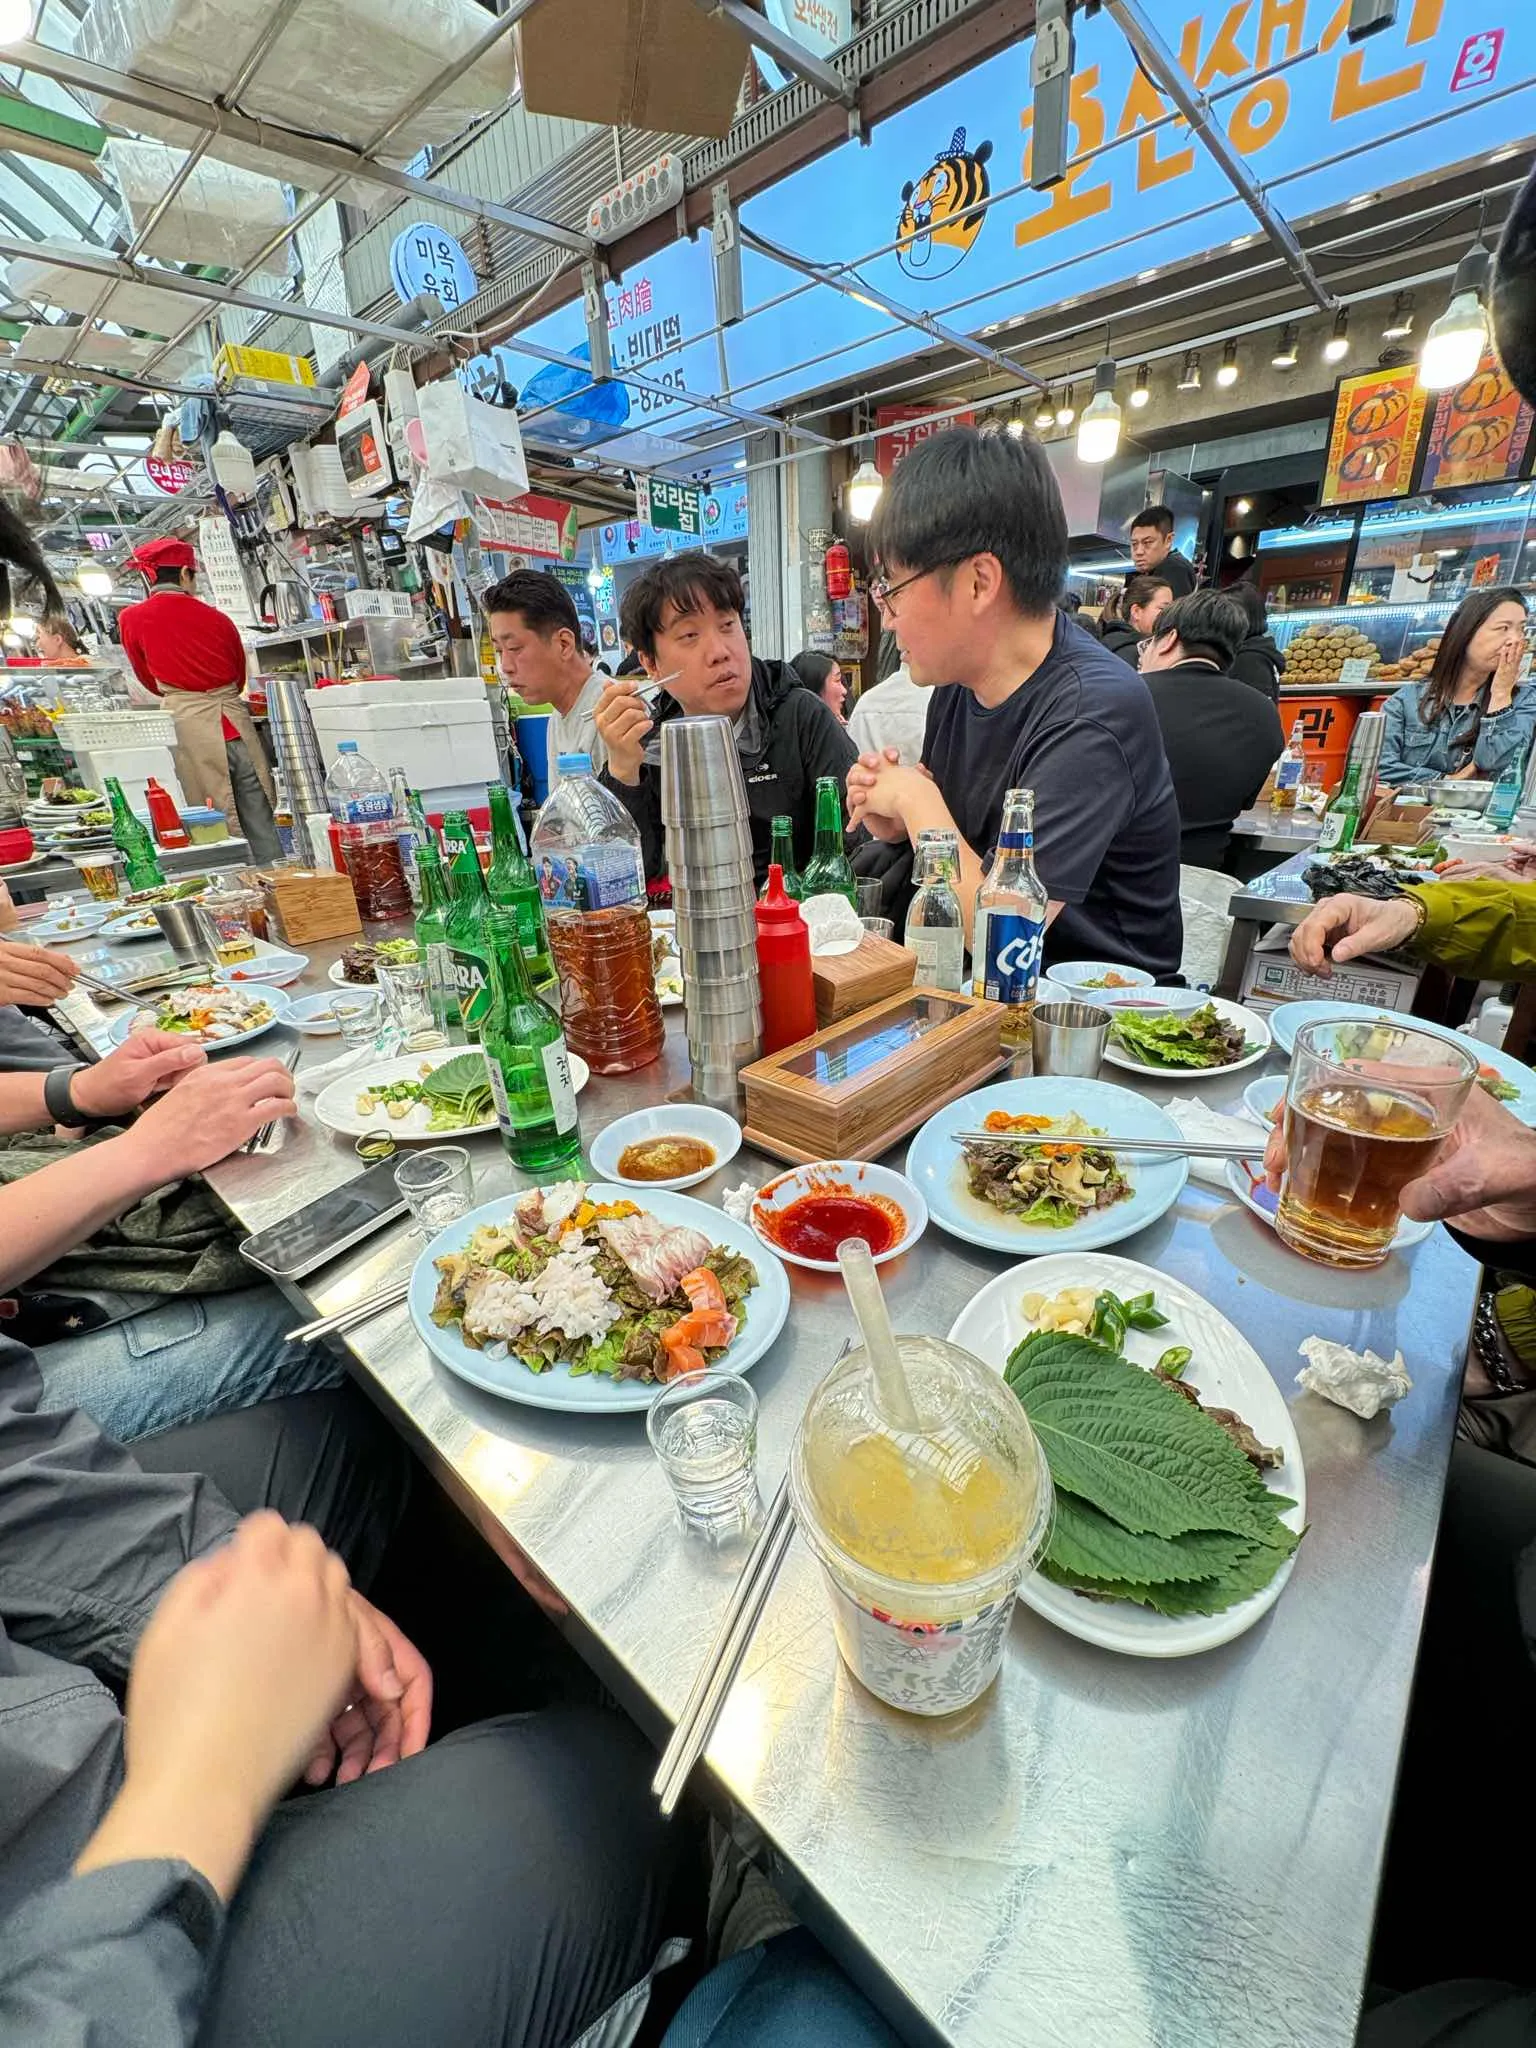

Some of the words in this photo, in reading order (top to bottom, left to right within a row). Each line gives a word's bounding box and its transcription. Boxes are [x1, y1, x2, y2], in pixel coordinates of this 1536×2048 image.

[415, 237, 455, 274] 미옥
[652, 482, 699, 512] 전라도
[679, 512, 695, 533] 집
[1299, 708, 1335, 749] 막
[446, 839, 468, 854] RRA
[996, 935, 1044, 976] Cas
[450, 962, 488, 990] RRA
